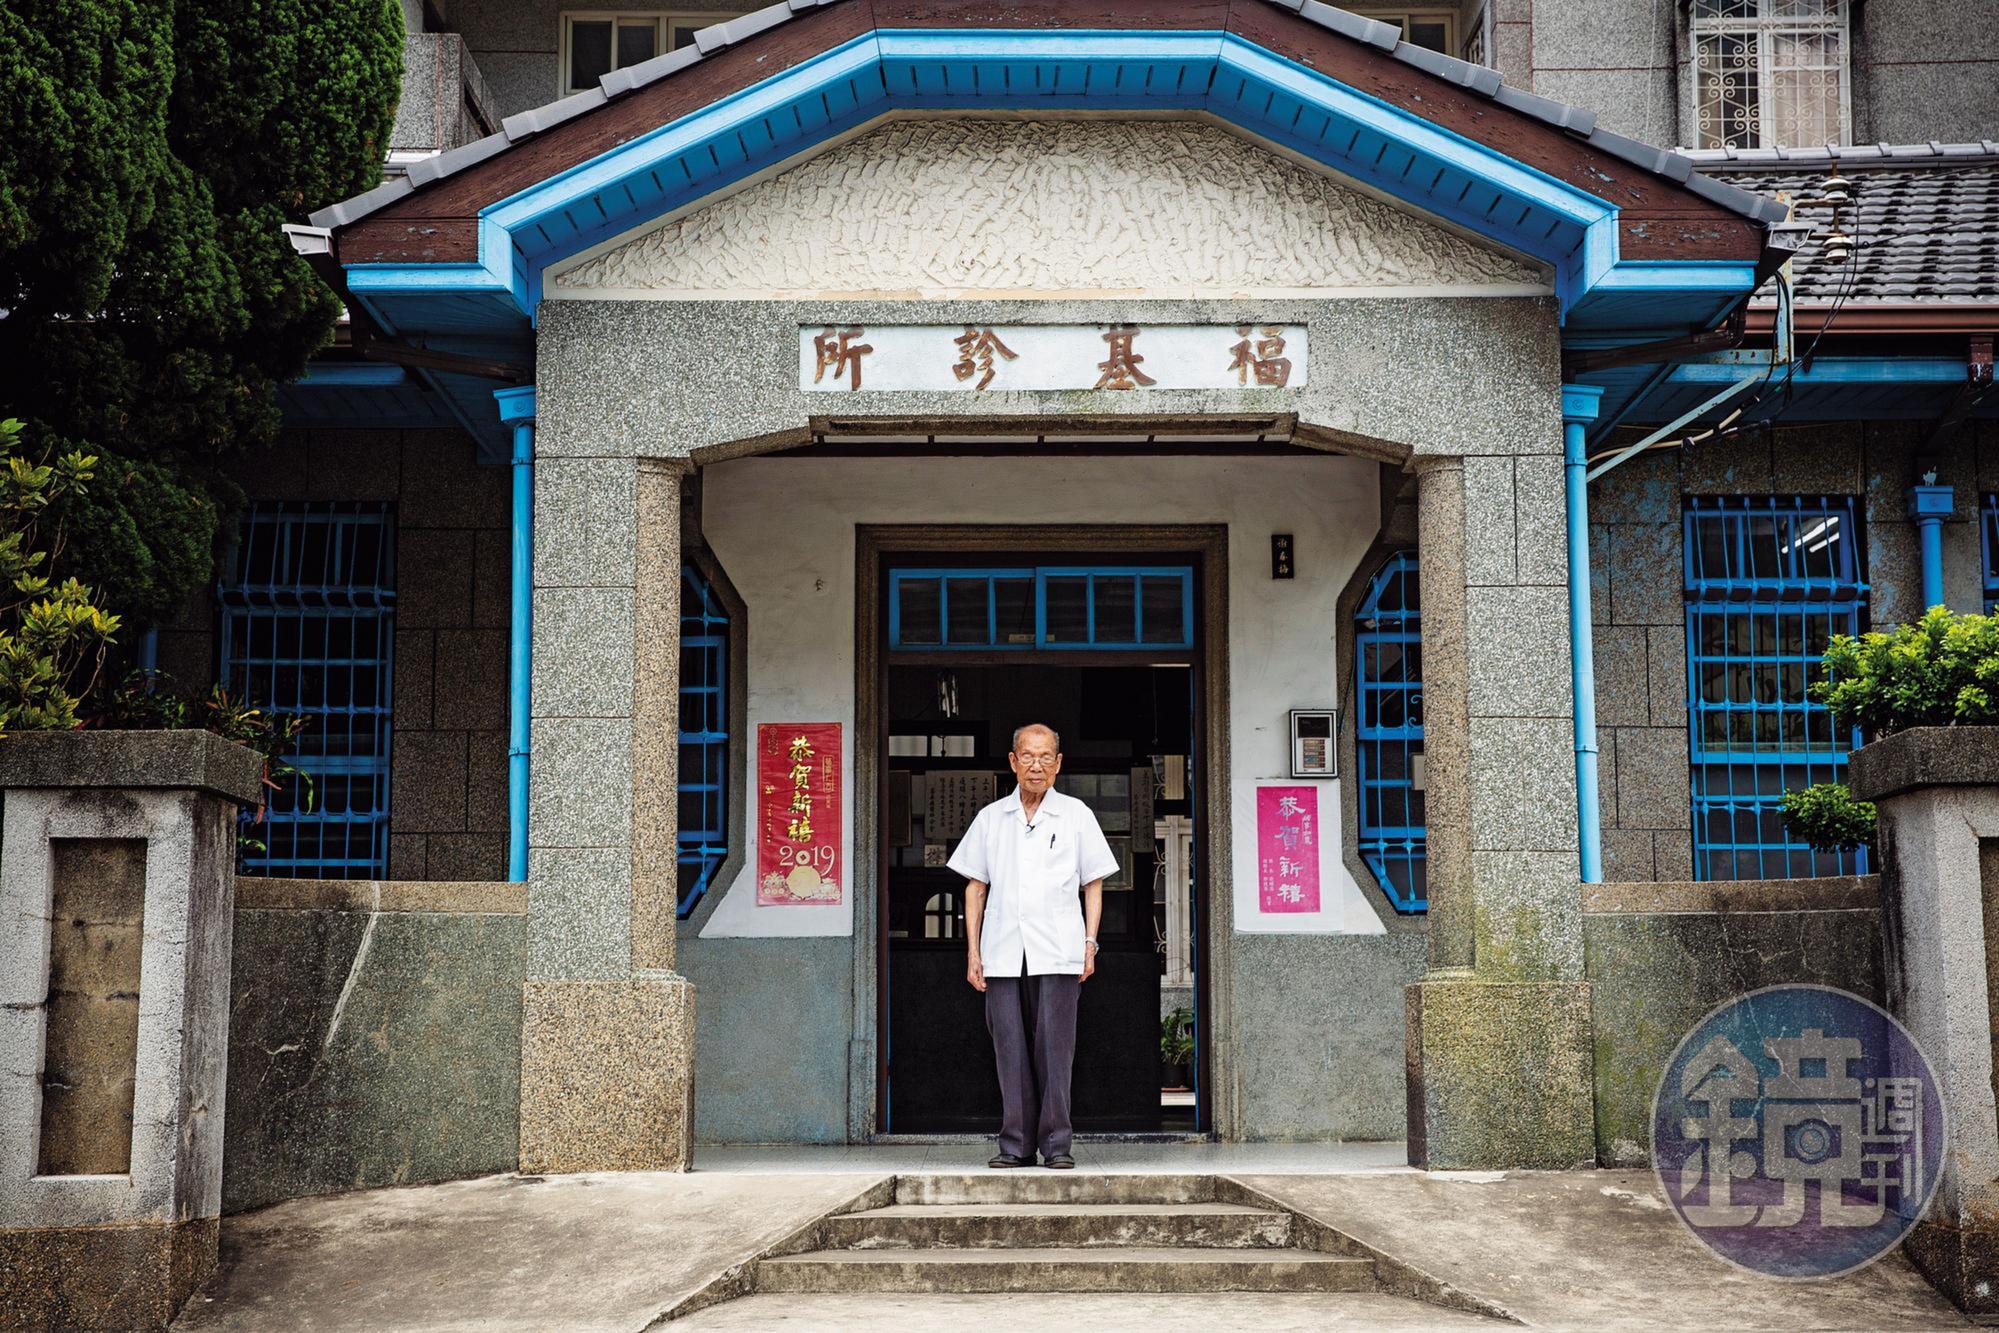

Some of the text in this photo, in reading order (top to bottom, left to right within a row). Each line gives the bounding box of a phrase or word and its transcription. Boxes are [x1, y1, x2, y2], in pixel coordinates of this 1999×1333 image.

[787, 735, 815, 844] 恭賀新禧
[1275, 796, 1306, 904] 恭賀新禧
